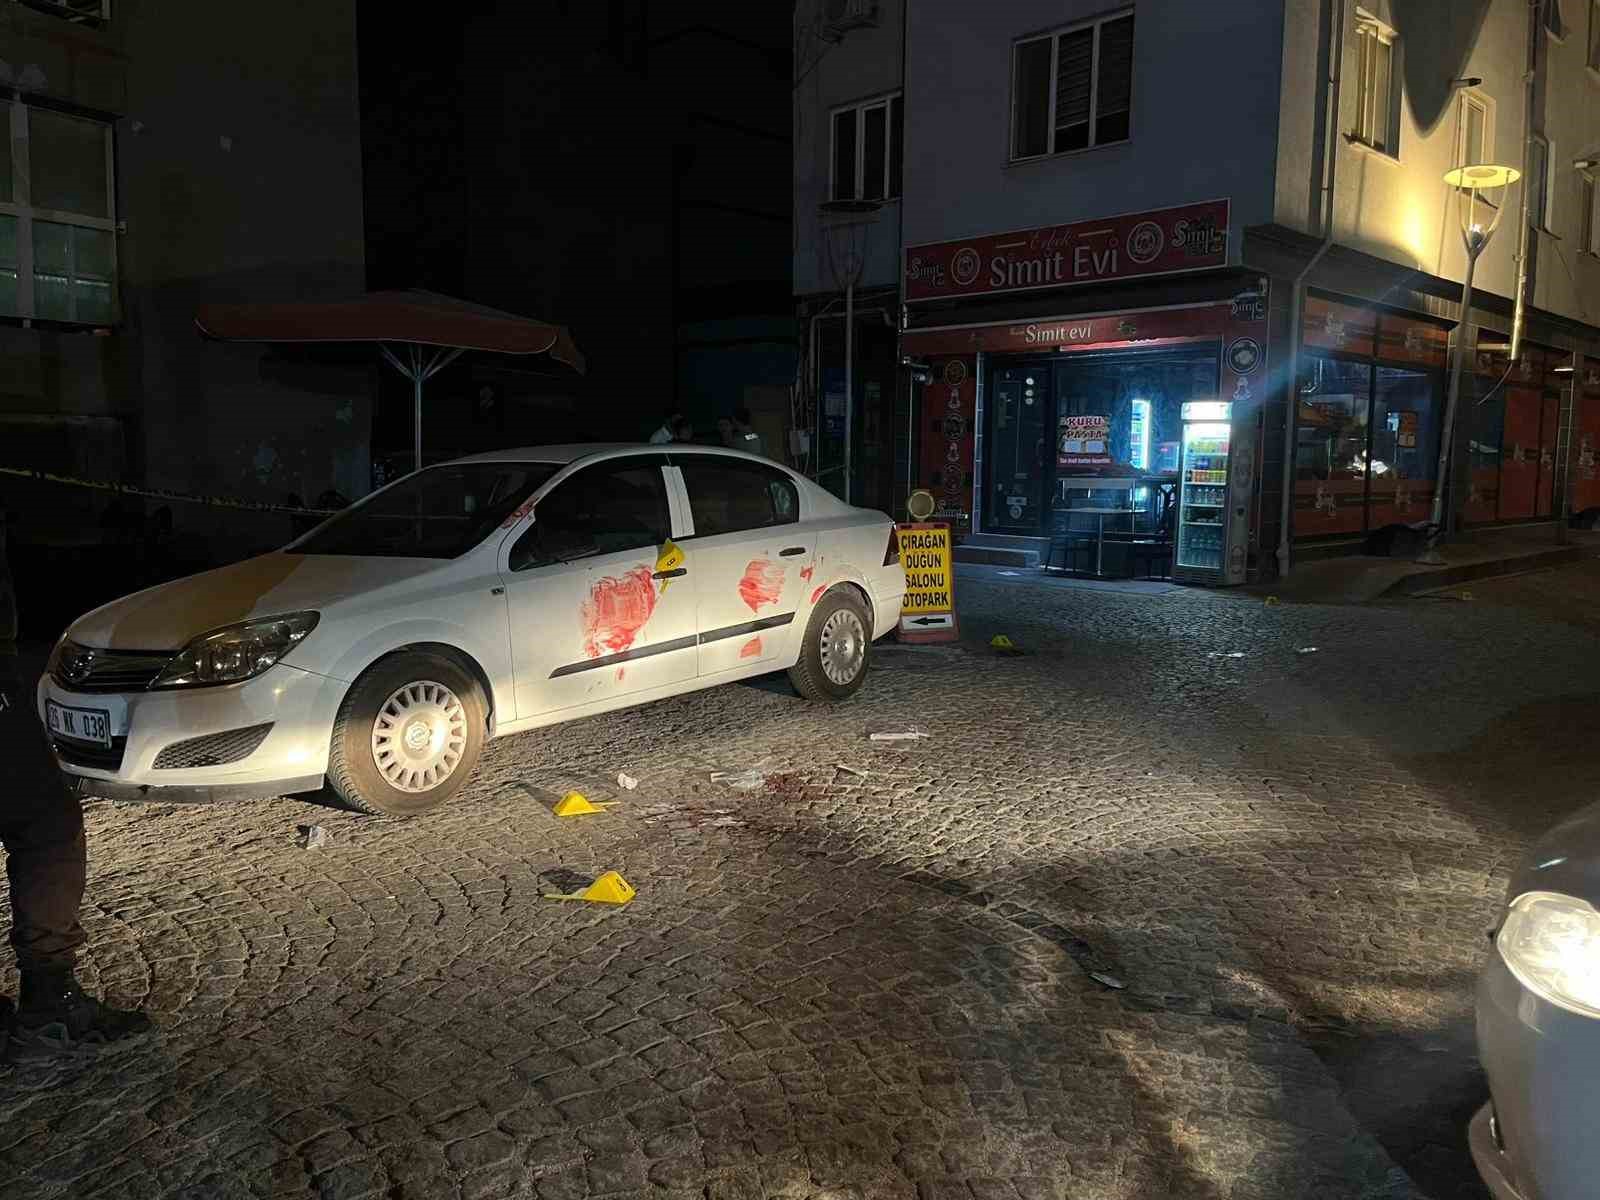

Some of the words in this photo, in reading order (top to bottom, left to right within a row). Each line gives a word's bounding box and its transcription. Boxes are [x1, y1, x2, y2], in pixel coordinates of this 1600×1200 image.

[990, 250, 1065, 288] Simit
[1073, 240, 1119, 277] Evi
[1025, 323, 1065, 344] Simit
[1069, 322, 1092, 340] evi
[901, 531, 945, 551] ÇIRAĞAN
[905, 573, 944, 588] SALONU
[903, 591, 949, 608] OTOPARK
[83, 714, 105, 738] 038
